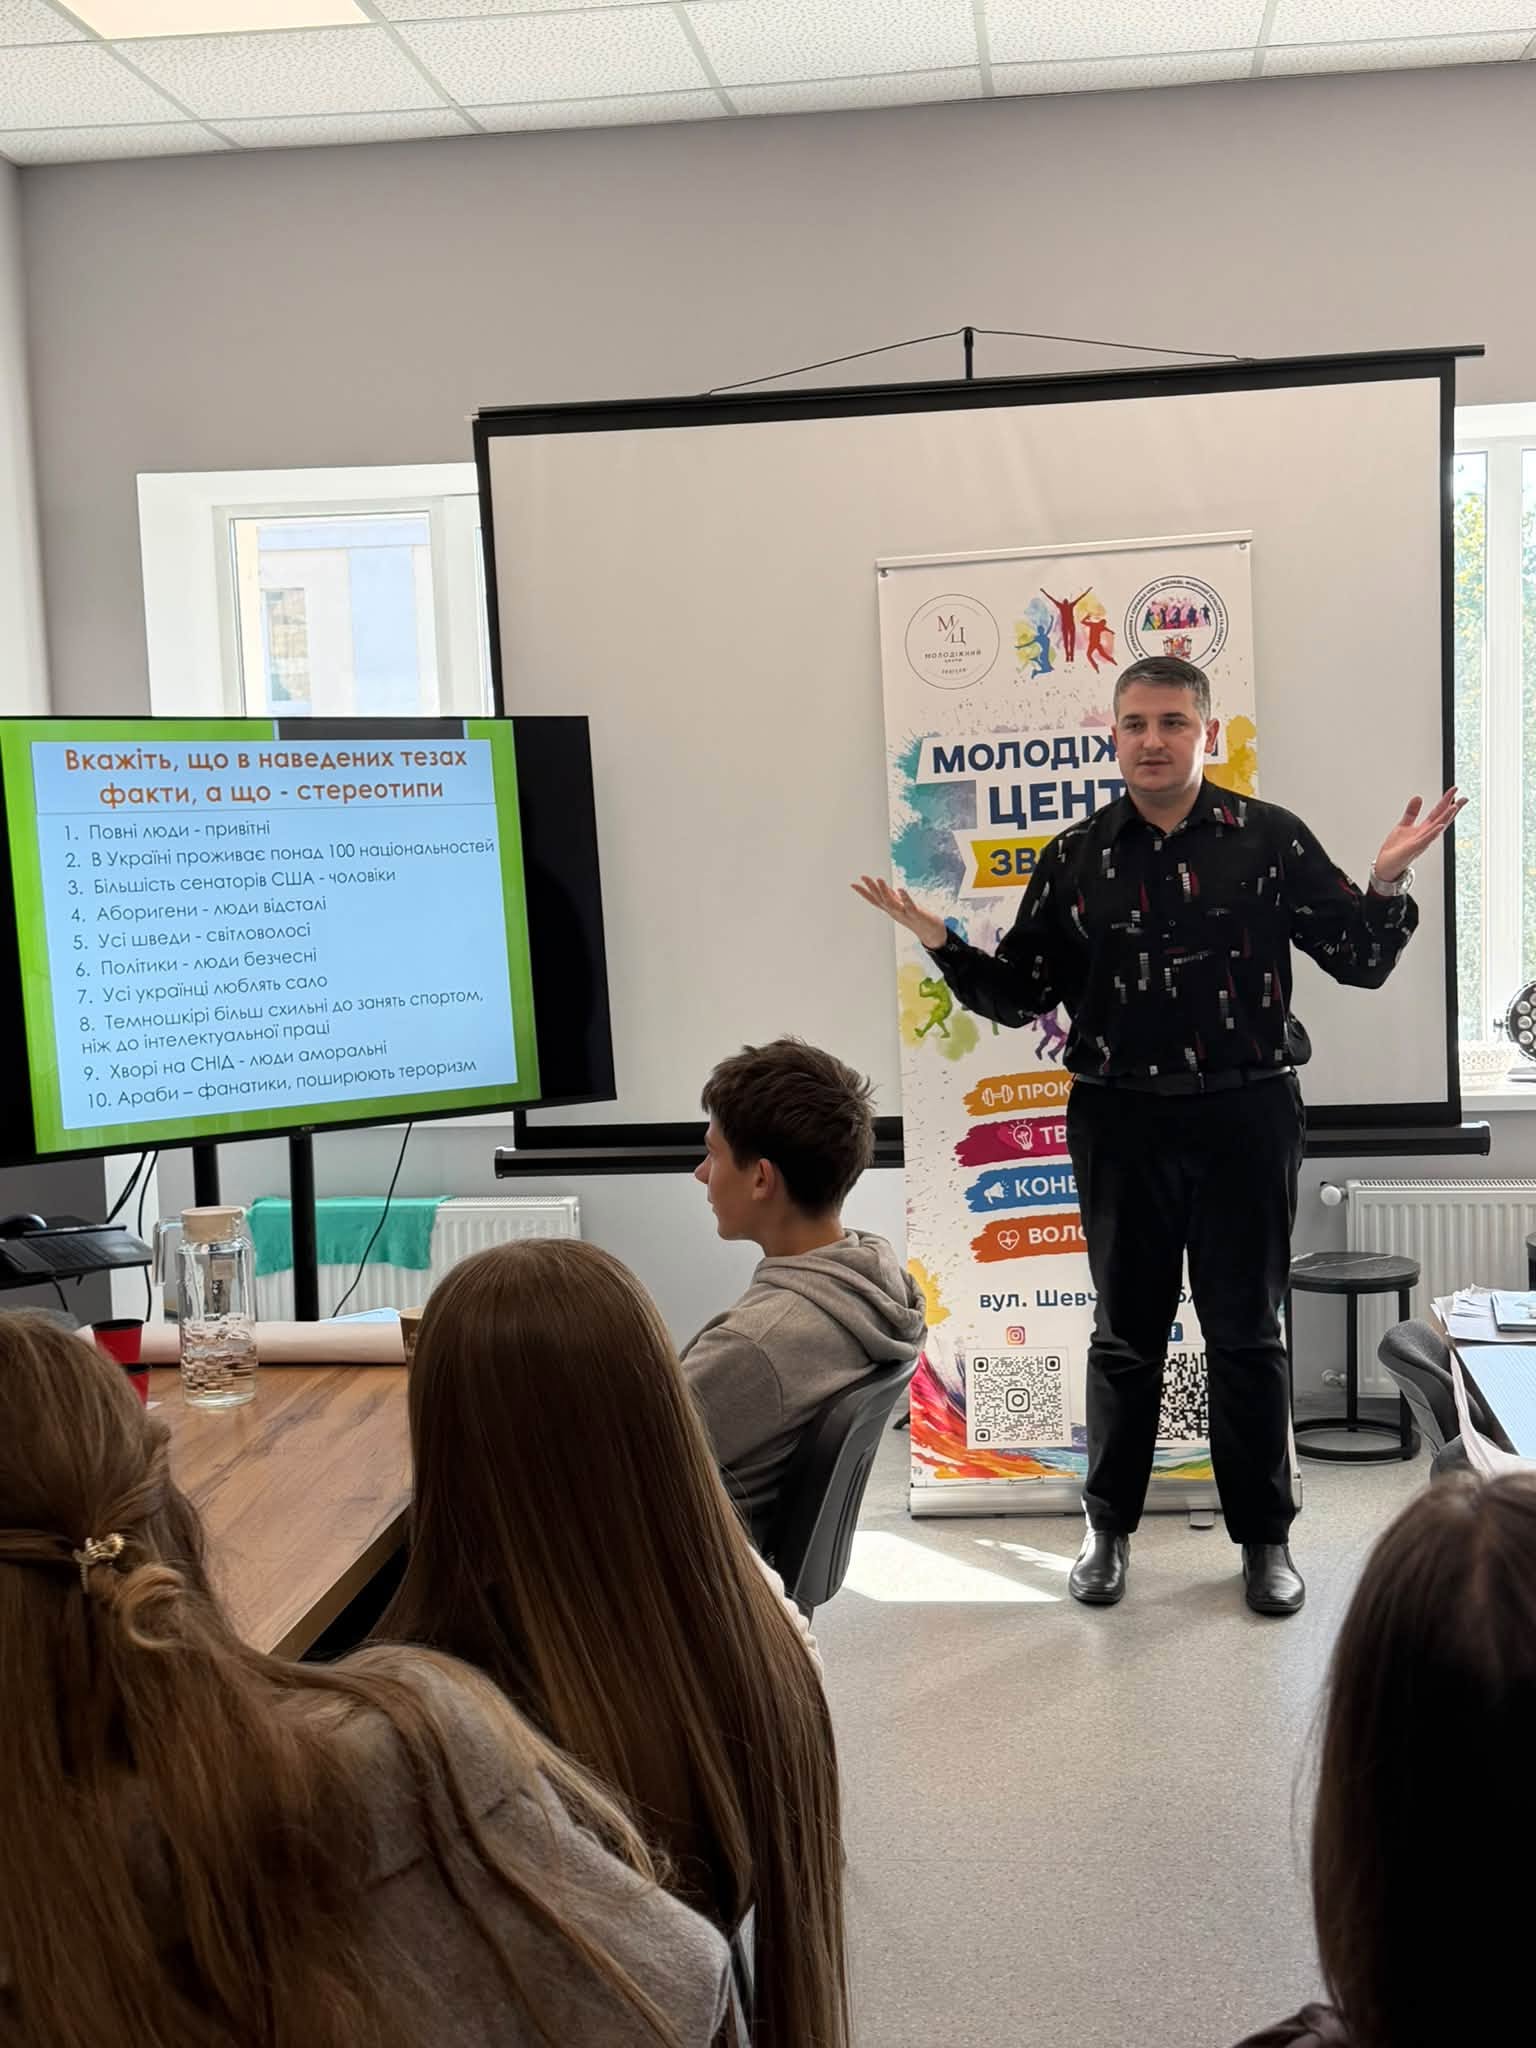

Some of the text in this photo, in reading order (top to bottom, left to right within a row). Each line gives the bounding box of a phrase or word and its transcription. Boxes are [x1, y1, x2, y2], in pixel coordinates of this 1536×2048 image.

[65, 748, 467, 771] Вкажіть, що в наведених тезах
[100, 783, 196, 809] факти,
[206, 786, 221, 801] а
[232, 785, 270, 803] що
[297, 782, 443, 804] стереотипи
[65, 825, 79, 840] 1.
[89, 824, 137, 839] Повні
[143, 825, 189, 838] люди
[205, 820, 270, 840] привітні
[65, 838, 494, 869] 2. В Україні проживає понад 100 національностей
[68, 880, 83, 896] 3.
[95, 878, 175, 894] Більшість
[181, 873, 266, 891] сенаторів
[272, 871, 315, 887] США
[329, 868, 396, 884] чоловіки
[71, 909, 85, 923] 4.
[97, 903, 198, 922] Аборигени
[214, 903, 258, 916] люди
[264, 896, 326, 913] відсталі
[73, 935, 88, 950] 5.
[98, 932, 126, 948] Усі
[132, 932, 190, 947] шведи
[206, 922, 310, 942] світловолосі
[76, 962, 90, 977] 6.
[101, 957, 178, 976] Політики
[194, 956, 239, 969] люди
[244, 947, 317, 966] безчесні
[77, 976, 328, 1004] 7. Усі українці люблять сало
[80, 991, 483, 1031] 8. Темношкірі більш схильні до занять спортом,
[82, 1020, 330, 1055] ніж до інтелектуальної праці
[84, 1066, 99, 1081] 9.
[110, 1060, 158, 1080] Хворі
[163, 1060, 185, 1073] на
[191, 1055, 234, 1072] СНІД
[250, 1053, 294, 1067] люди
[298, 1040, 387, 1063] аморальні
[88, 1092, 112, 1108] 10.
[118, 1087, 179, 1107] Араби
[198, 1078, 292, 1100] фанатики,
[297, 1067, 395, 1089] поширюють
[400, 1060, 477, 1079] тероризм
[980, 1293, 1027, 1311] вул.
